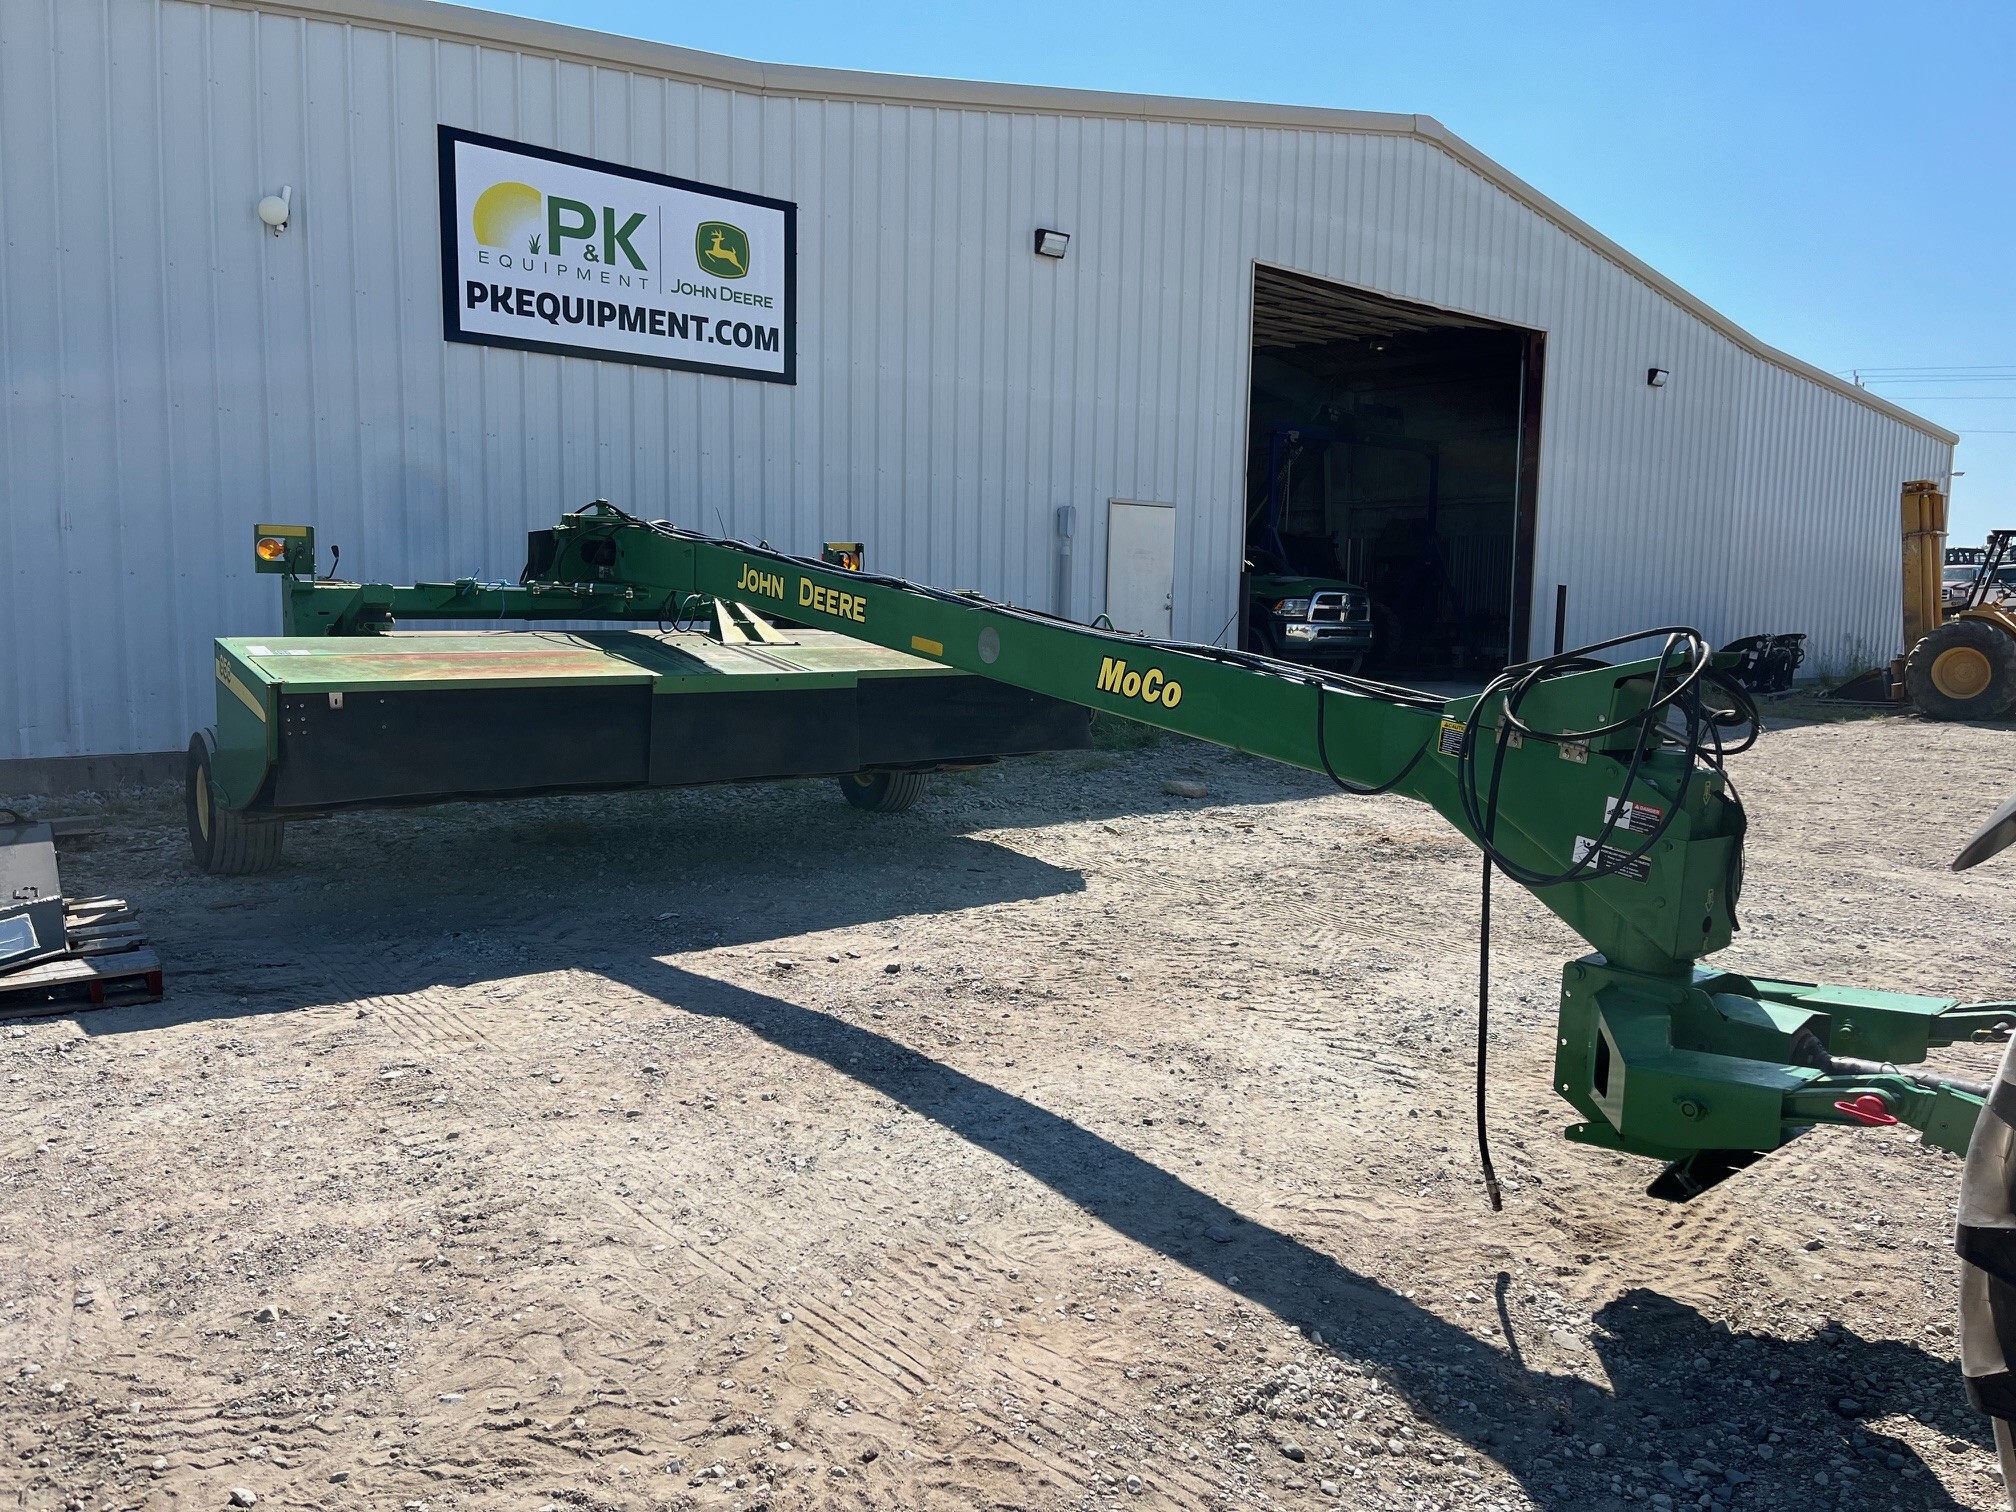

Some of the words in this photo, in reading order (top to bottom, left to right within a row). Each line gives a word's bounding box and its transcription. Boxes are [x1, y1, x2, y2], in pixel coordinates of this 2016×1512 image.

[547, 195, 648, 271] P&K
[479, 250, 649, 290] EQUIPMENT
[670, 278, 717, 299] JOHN
[720, 286, 774, 309] DEERE
[466, 280, 779, 352] PKEQUIPMENT.COM
[737, 562, 784, 600] JOHN
[798, 576, 867, 623] DEERE
[1096, 656, 1183, 709] MoCo
